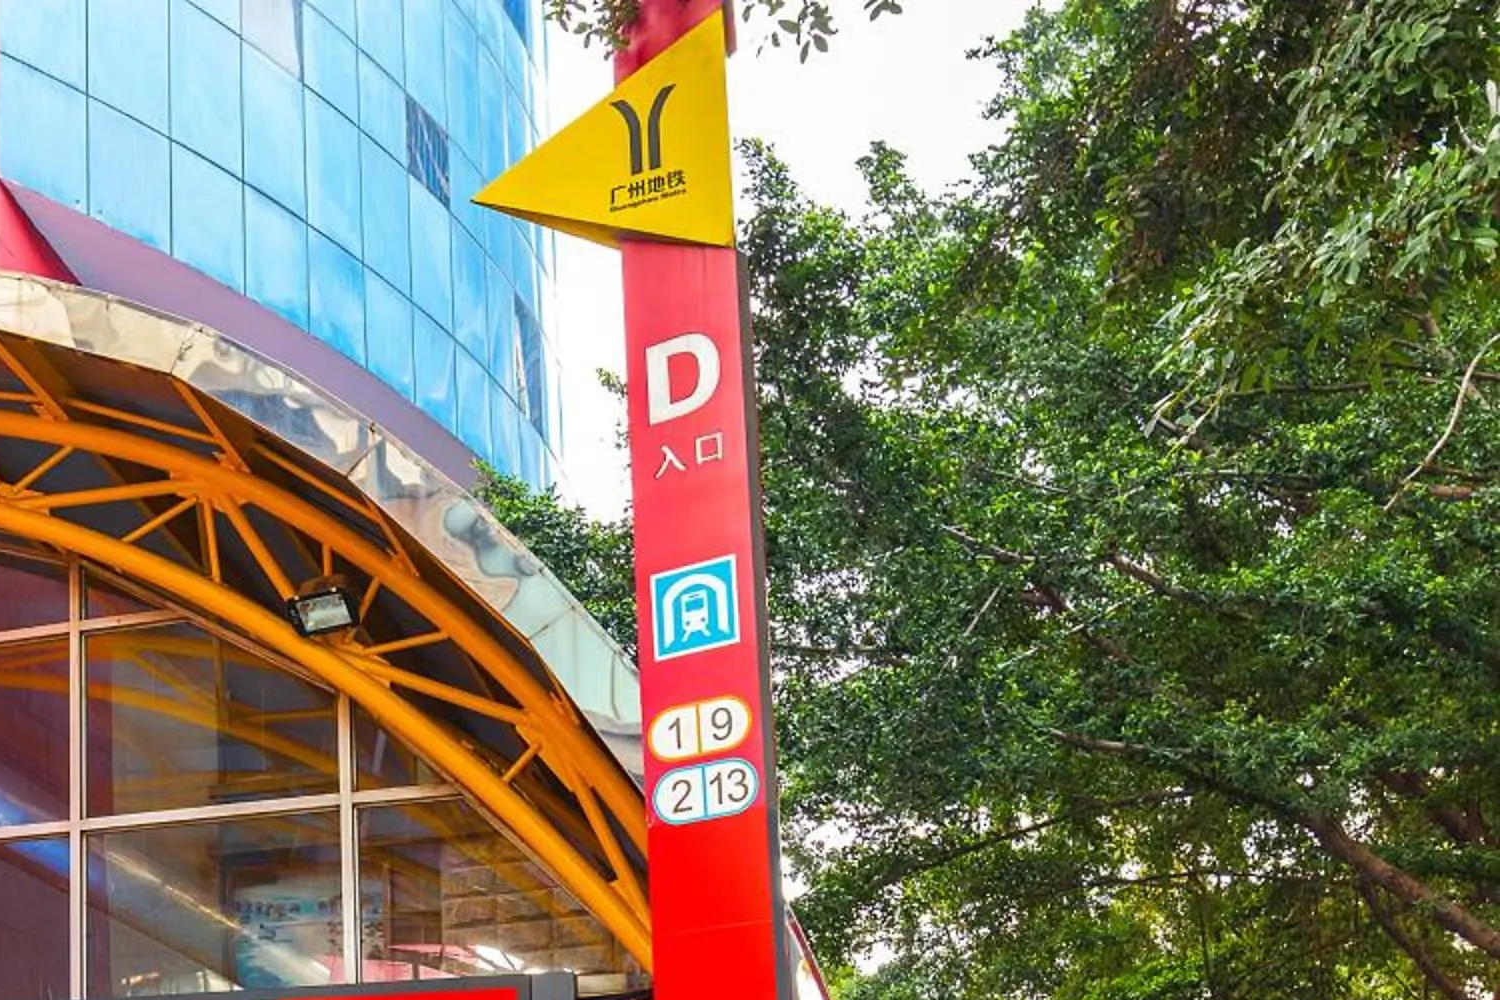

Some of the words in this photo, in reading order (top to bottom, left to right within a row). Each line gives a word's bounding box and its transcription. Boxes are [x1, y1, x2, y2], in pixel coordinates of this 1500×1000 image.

[610, 169, 687, 205] 广州地铁
[645, 332, 721, 427] D
[655, 431, 723, 480] 入口
[668, 716, 682, 751] 1
[710, 706, 734, 742] 9
[671, 778, 694, 815] 2
[709, 767, 750, 806] 13
